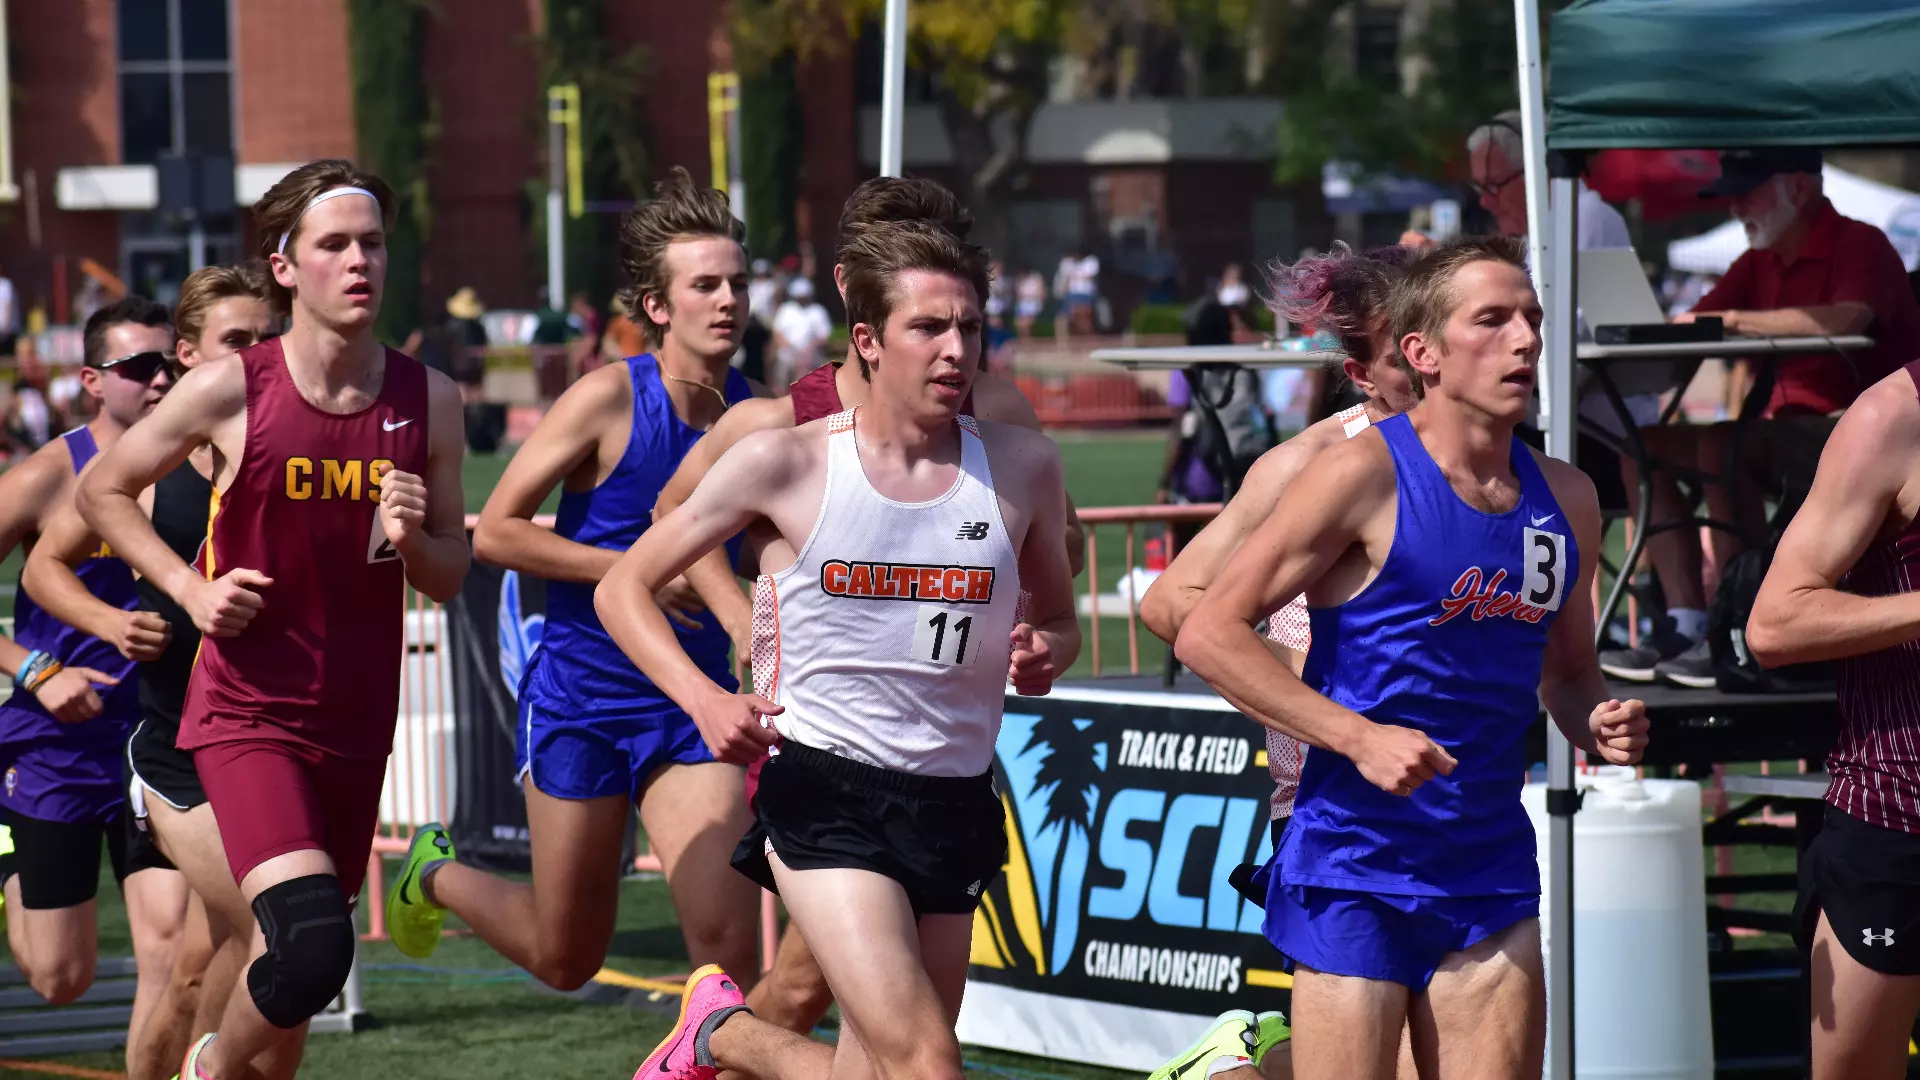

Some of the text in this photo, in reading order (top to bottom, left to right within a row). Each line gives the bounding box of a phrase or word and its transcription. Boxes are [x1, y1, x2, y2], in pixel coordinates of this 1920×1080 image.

[286, 456, 395, 503] CMS
[821, 559, 995, 604] CALTECH
[1530, 535, 1556, 605] 3
[929, 612, 972, 664] 11
[1118, 729, 1249, 775] TRACK & FIELD
[1084, 939, 1242, 994] CHAMPIONSHIPS
